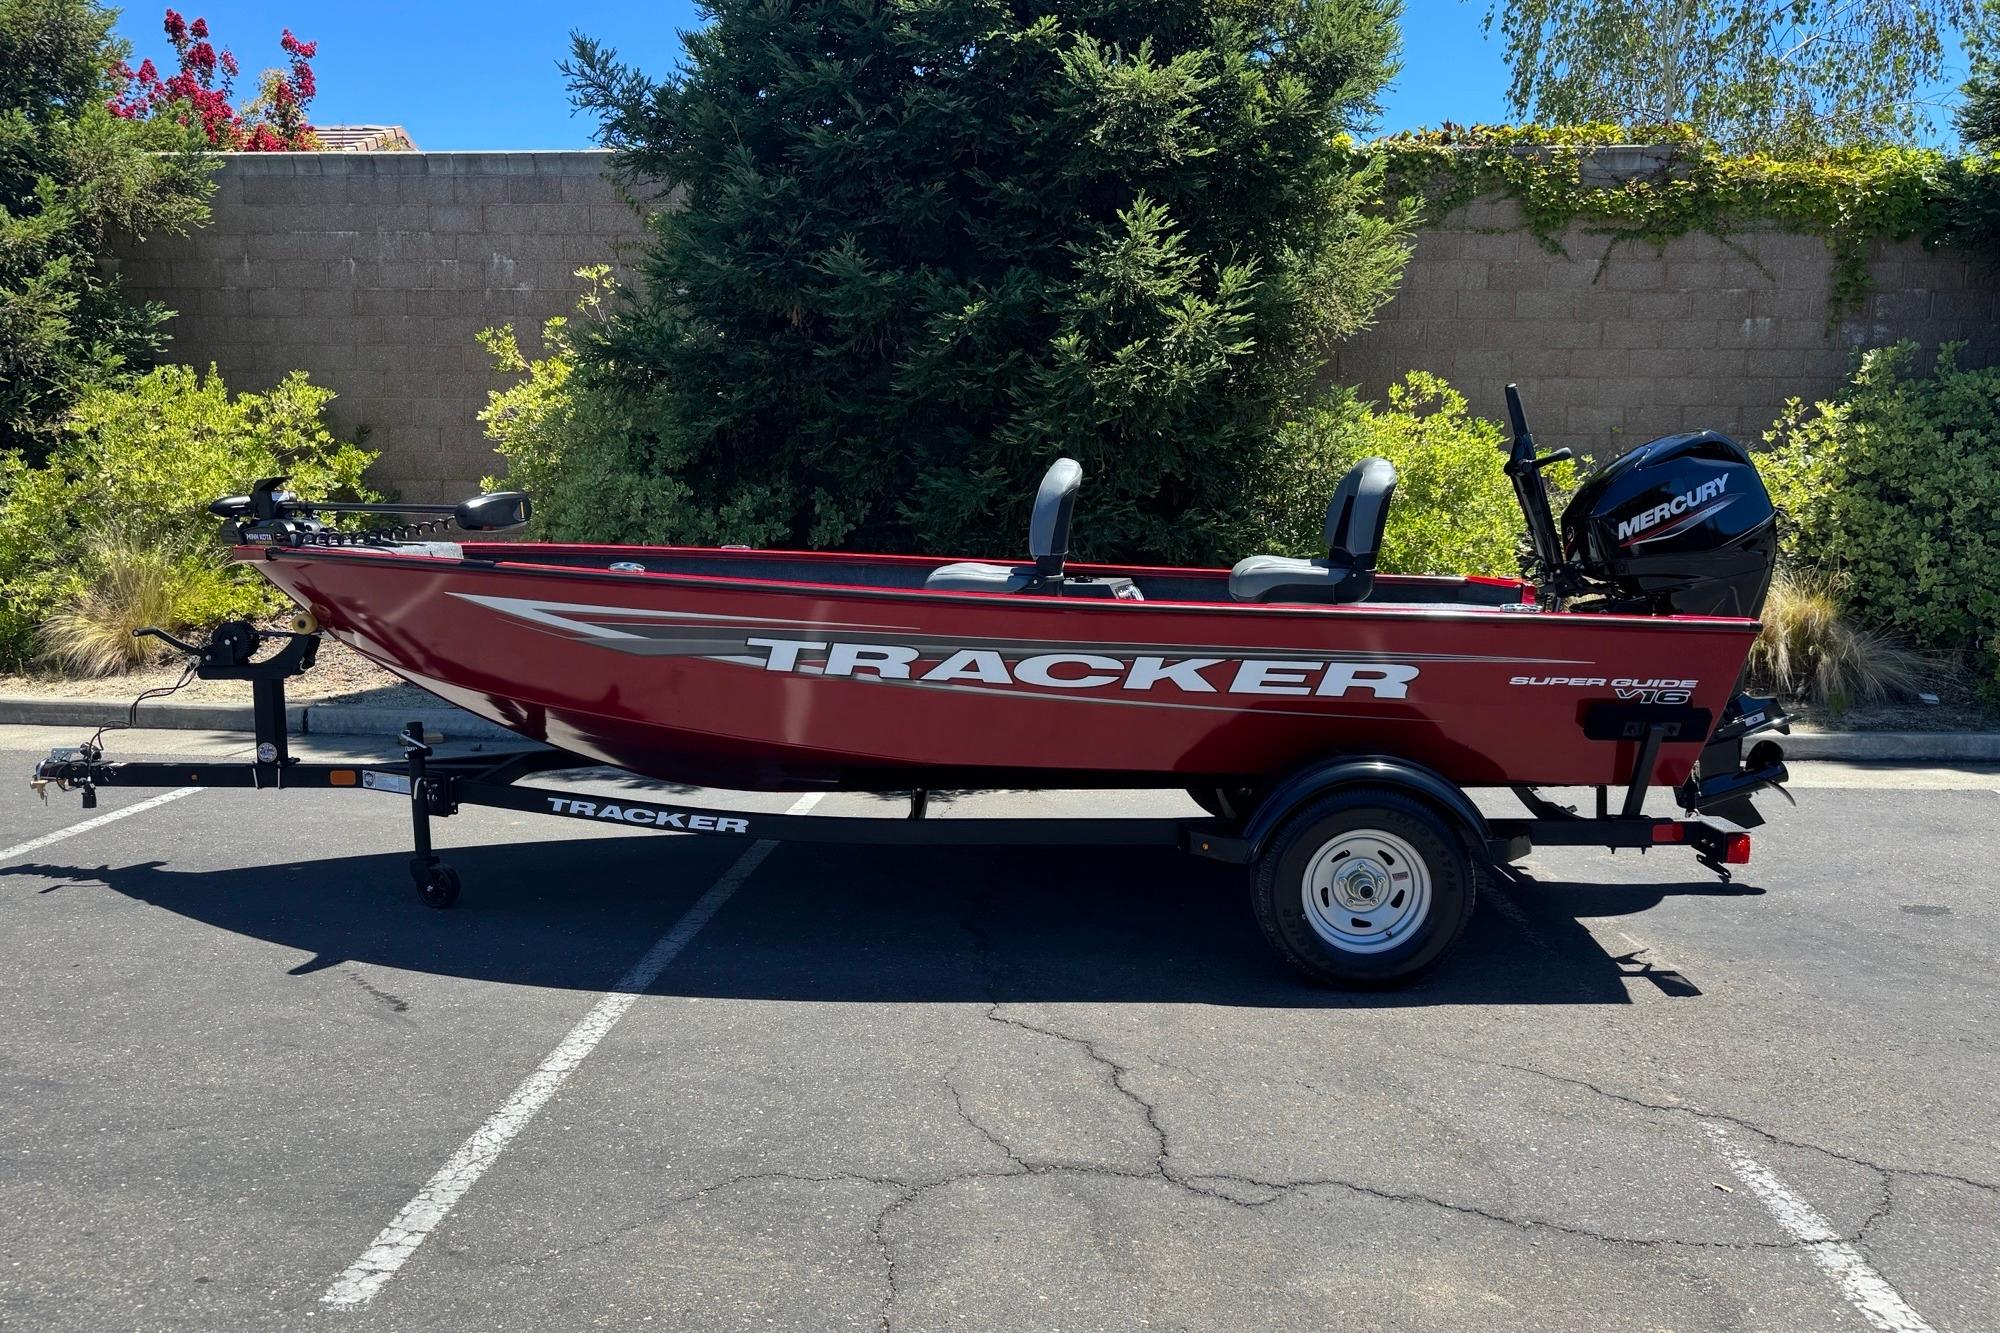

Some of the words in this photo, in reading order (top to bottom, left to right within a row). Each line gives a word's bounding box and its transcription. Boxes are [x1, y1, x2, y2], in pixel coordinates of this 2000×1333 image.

[1618, 473, 1728, 540] MERCURY
[246, 533, 259, 541] MINN
[260, 533, 272, 541] KOTA
[745, 636, 1420, 699] TRACKER
[1509, 677, 1607, 687] SUPER
[1611, 678, 1699, 688] GUIDE
[1615, 688, 1691, 704] V16
[547, 797, 750, 834] TRACKER
